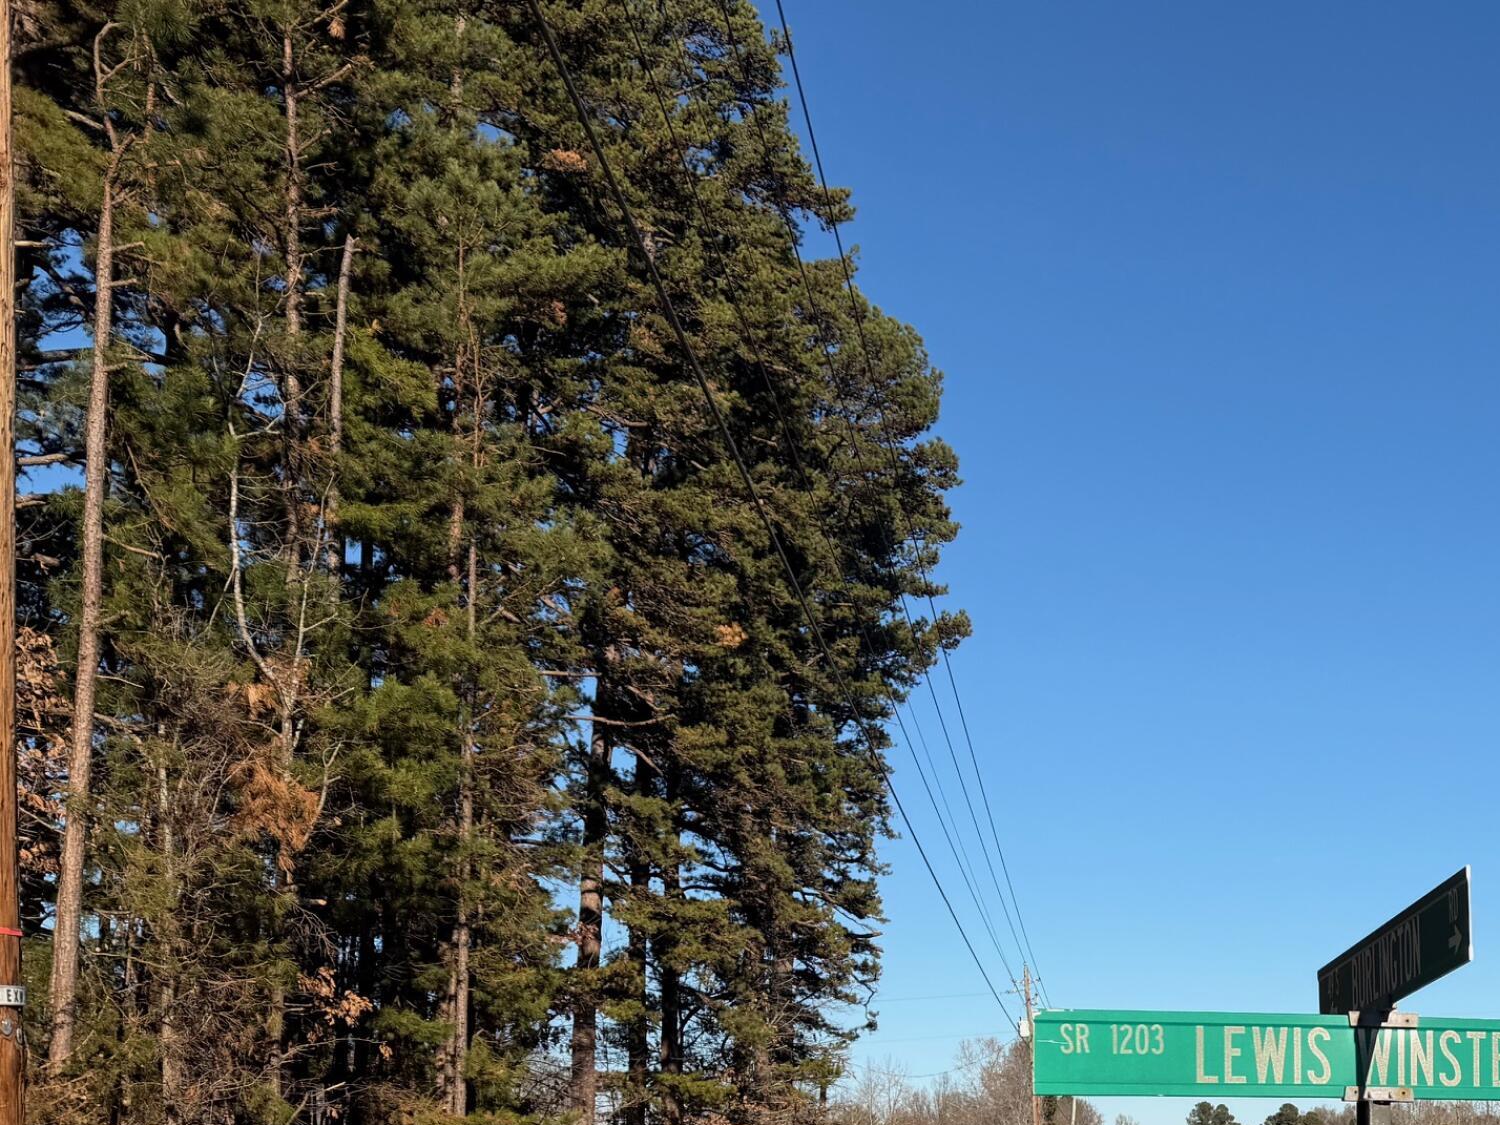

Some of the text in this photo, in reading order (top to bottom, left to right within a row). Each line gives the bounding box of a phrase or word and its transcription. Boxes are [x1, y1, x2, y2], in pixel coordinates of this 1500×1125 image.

[1351, 913, 1421, 1009] BURLINGTON
[1060, 1023, 1091, 1055] SR
[1110, 1024, 1165, 1055] 1203
[1195, 1025, 1332, 1085] LEWIS
